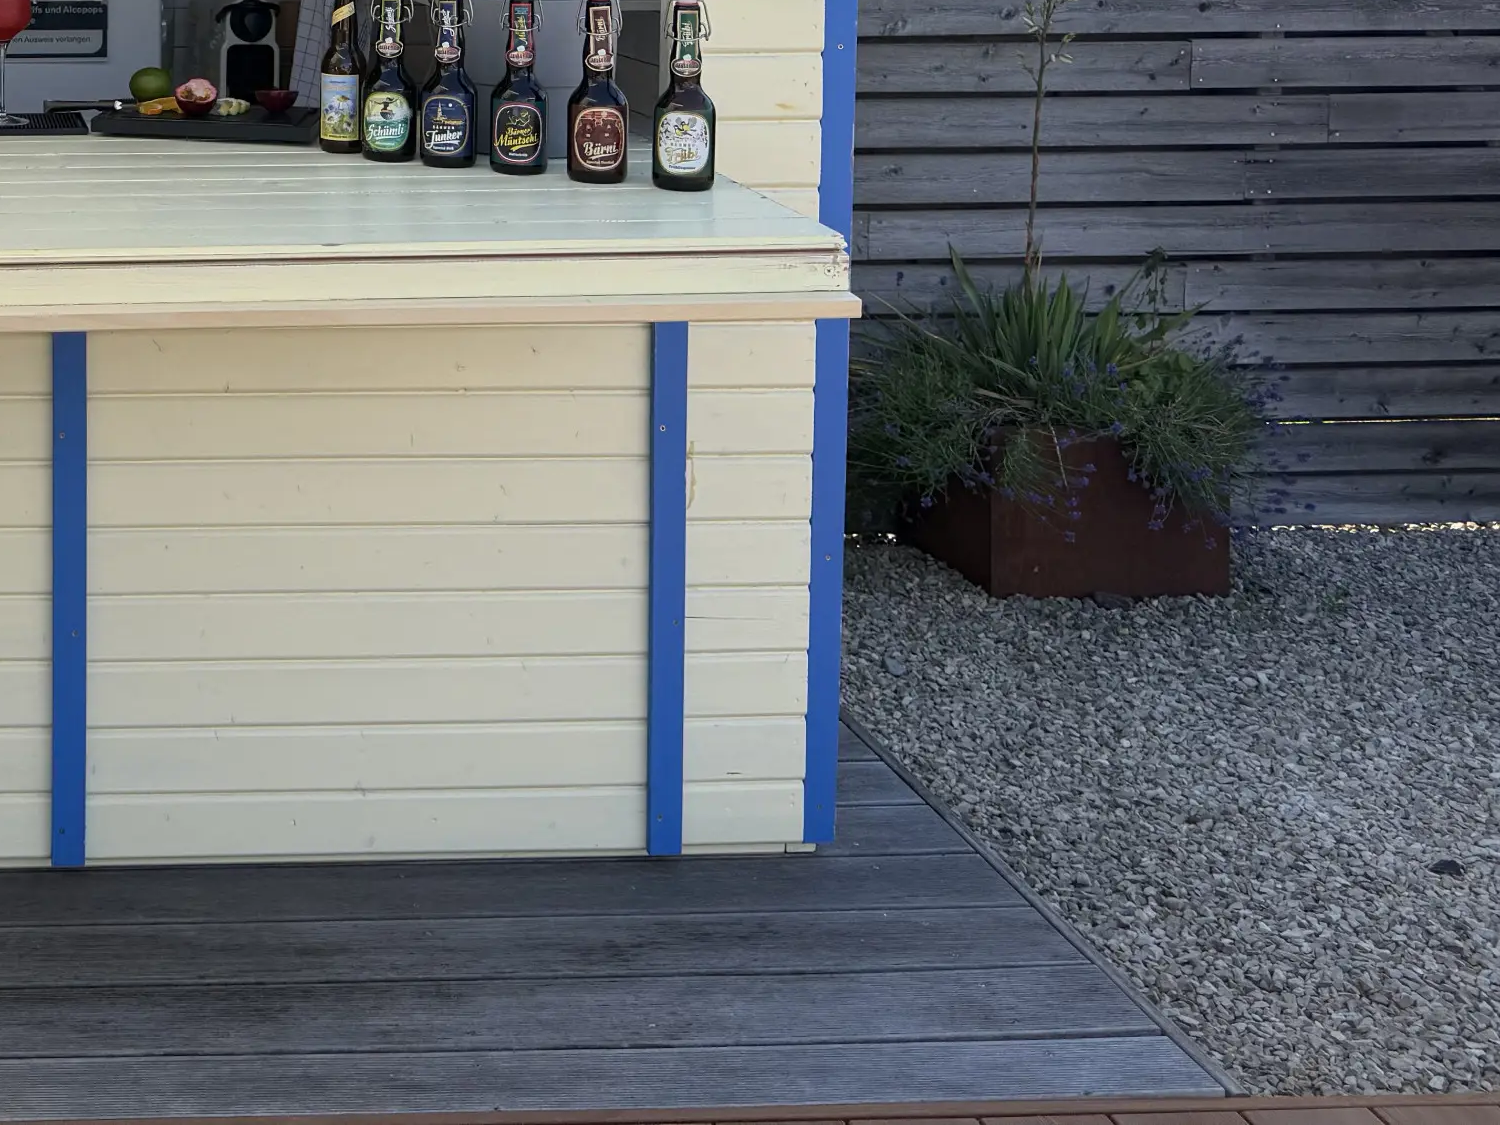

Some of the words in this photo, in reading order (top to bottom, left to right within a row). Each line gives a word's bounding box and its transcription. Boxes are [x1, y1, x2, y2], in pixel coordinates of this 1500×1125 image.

[45, 6, 61, 14] und
[63, 6, 104, 16] Alcopops
[366, 123, 405, 141] Schümli
[424, 130, 463, 149] Junker
[583, 141, 618, 156] Bärni
